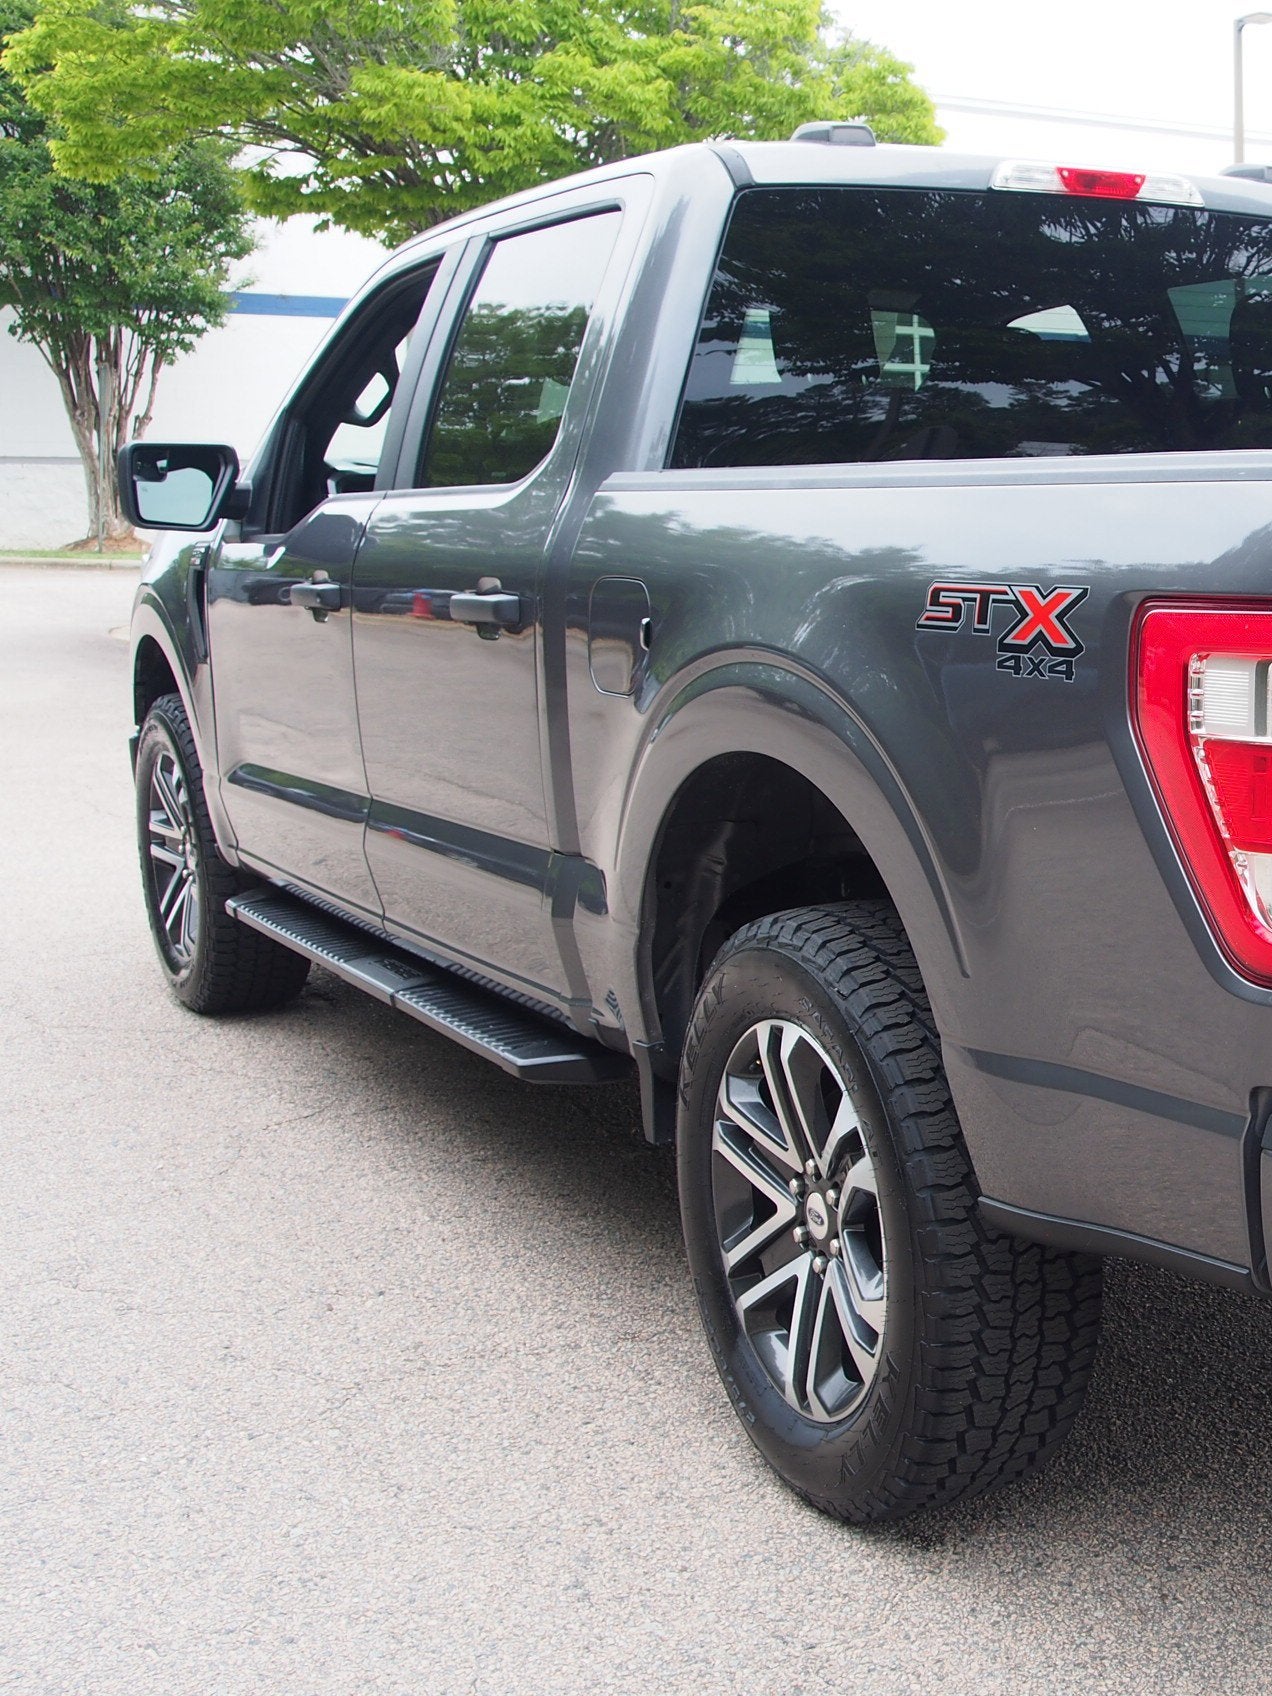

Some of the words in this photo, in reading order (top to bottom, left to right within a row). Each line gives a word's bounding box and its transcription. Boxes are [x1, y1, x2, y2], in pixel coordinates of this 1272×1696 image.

[915, 580, 1090, 659] STX
[679, 973, 728, 1111] KELLY
[841, 1352, 901, 1486] KELLY
